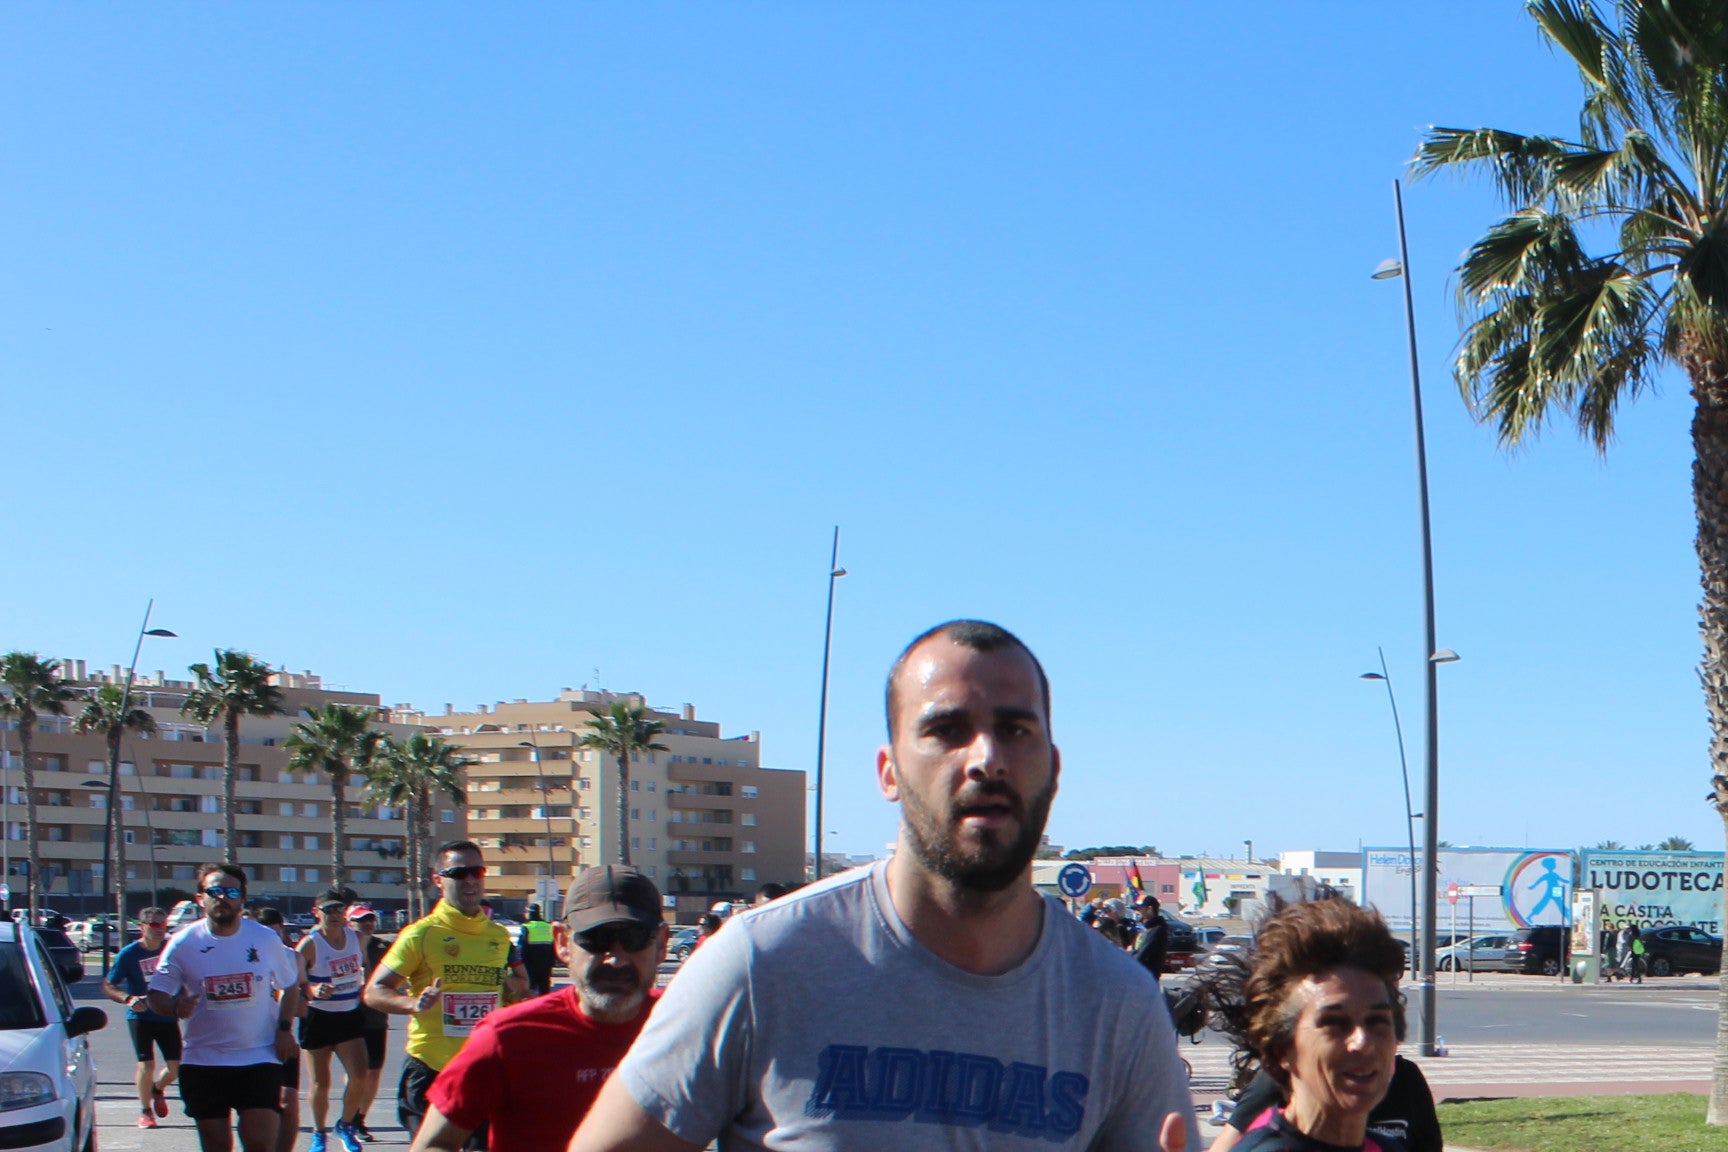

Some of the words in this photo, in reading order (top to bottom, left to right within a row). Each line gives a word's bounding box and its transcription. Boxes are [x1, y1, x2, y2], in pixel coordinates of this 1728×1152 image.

[1589, 859, 1624, 867] CENTRO
[1638, 858, 1688, 868] EDUCACIÓN
[1590, 869, 1725, 892] LUDOTECA
[1614, 905, 1673, 918] CASITA
[444, 965, 497, 974] RUNNERS
[217, 983, 244, 995] 245
[803, 1044, 1090, 1143] ADIDAS
